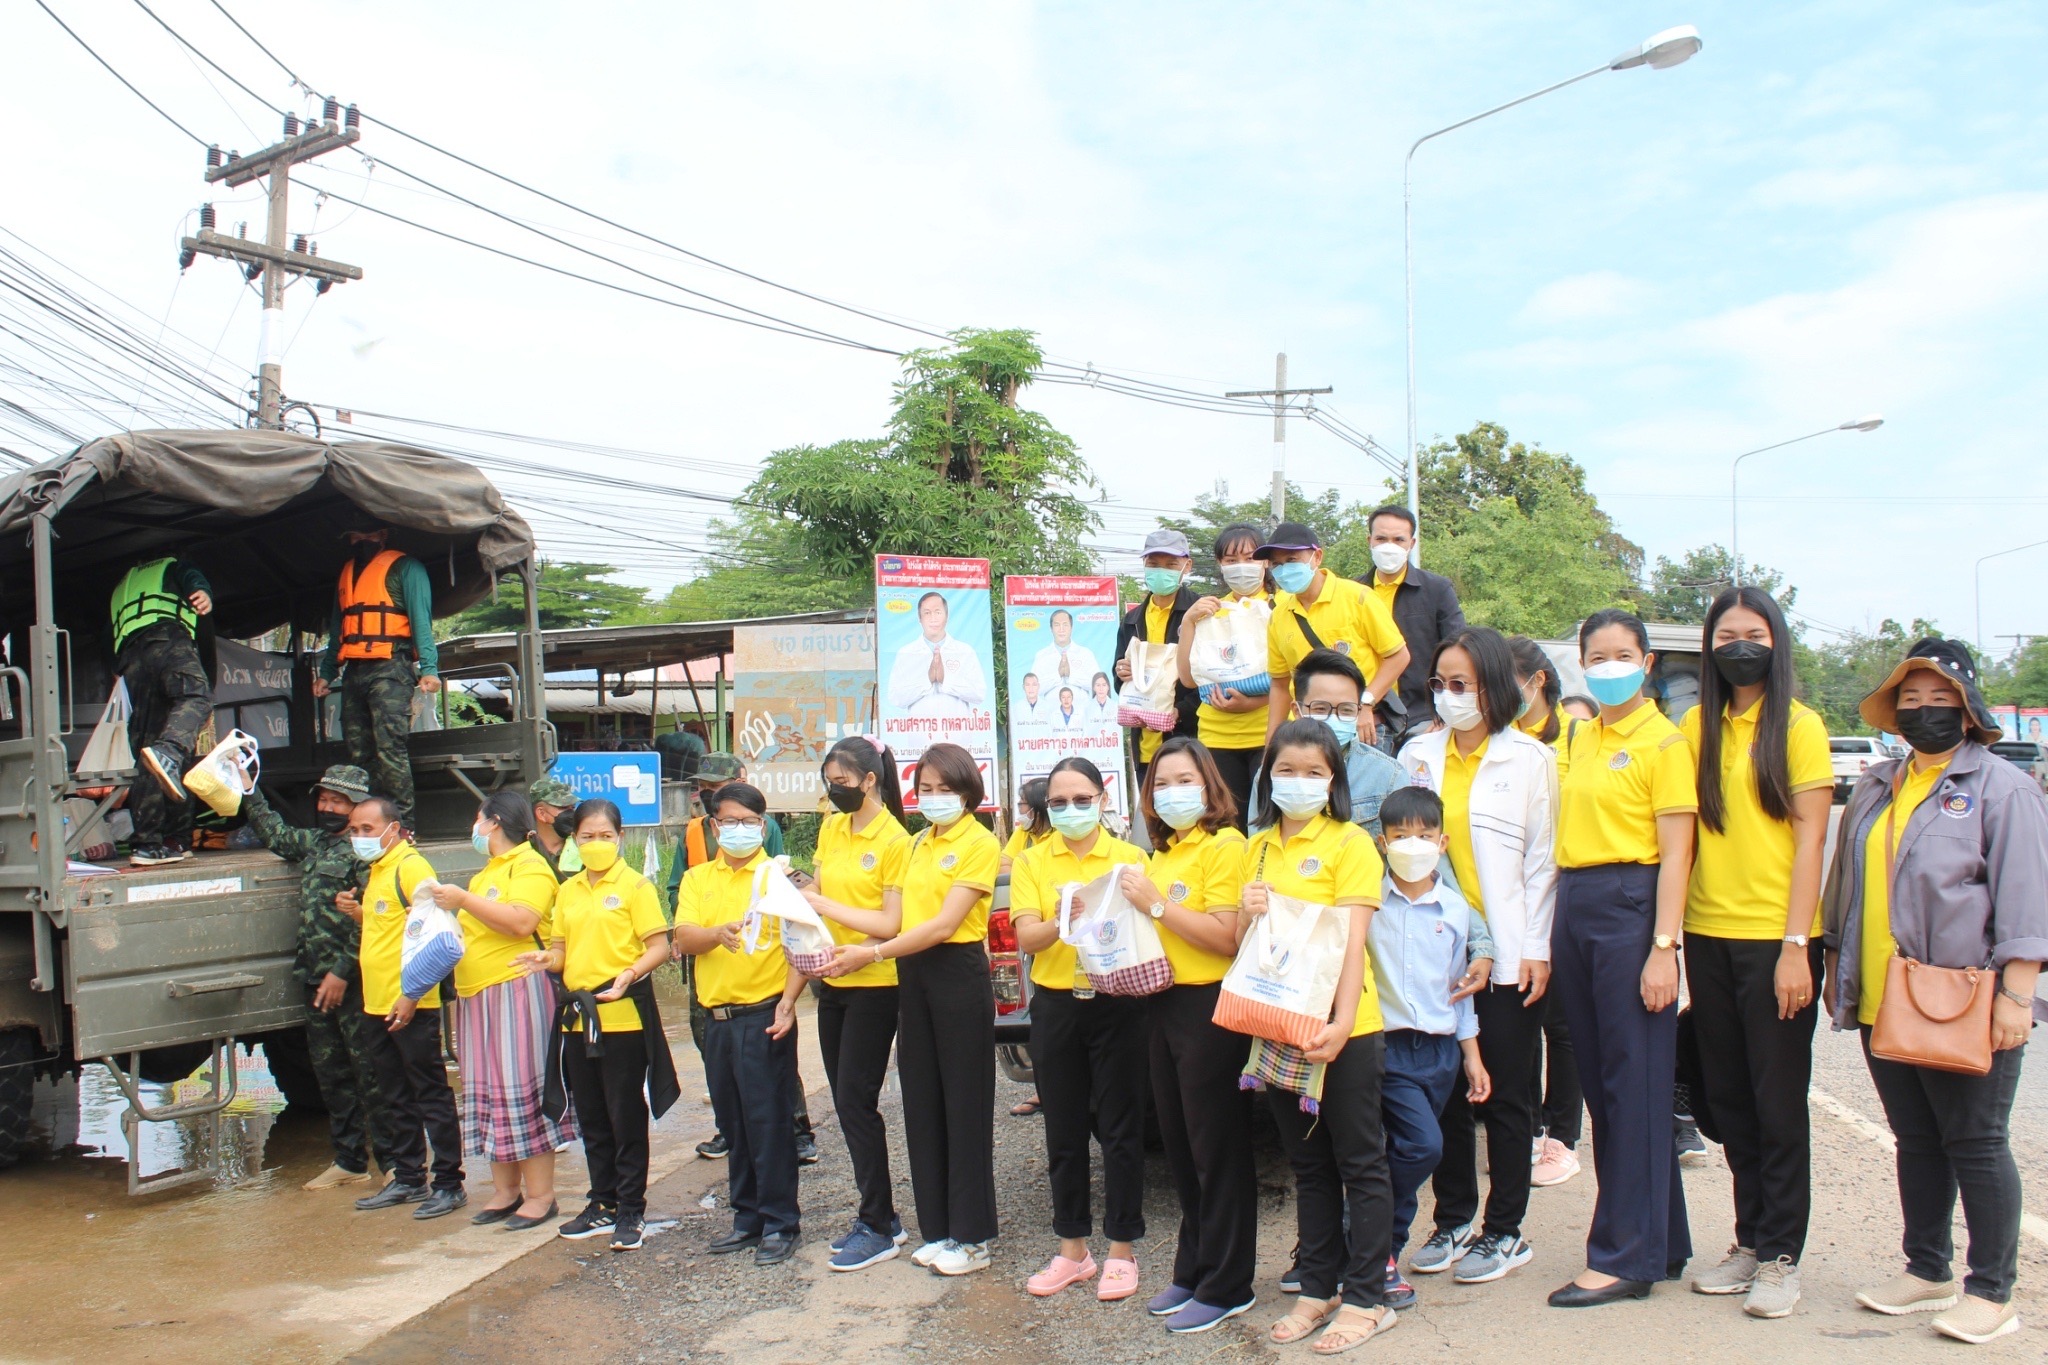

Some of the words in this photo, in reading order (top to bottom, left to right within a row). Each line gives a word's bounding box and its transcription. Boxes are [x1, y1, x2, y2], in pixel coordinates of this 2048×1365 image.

[886, 717, 938, 740] นายศราวุธ
[1018, 737, 1068, 756] นายศราวุธ
